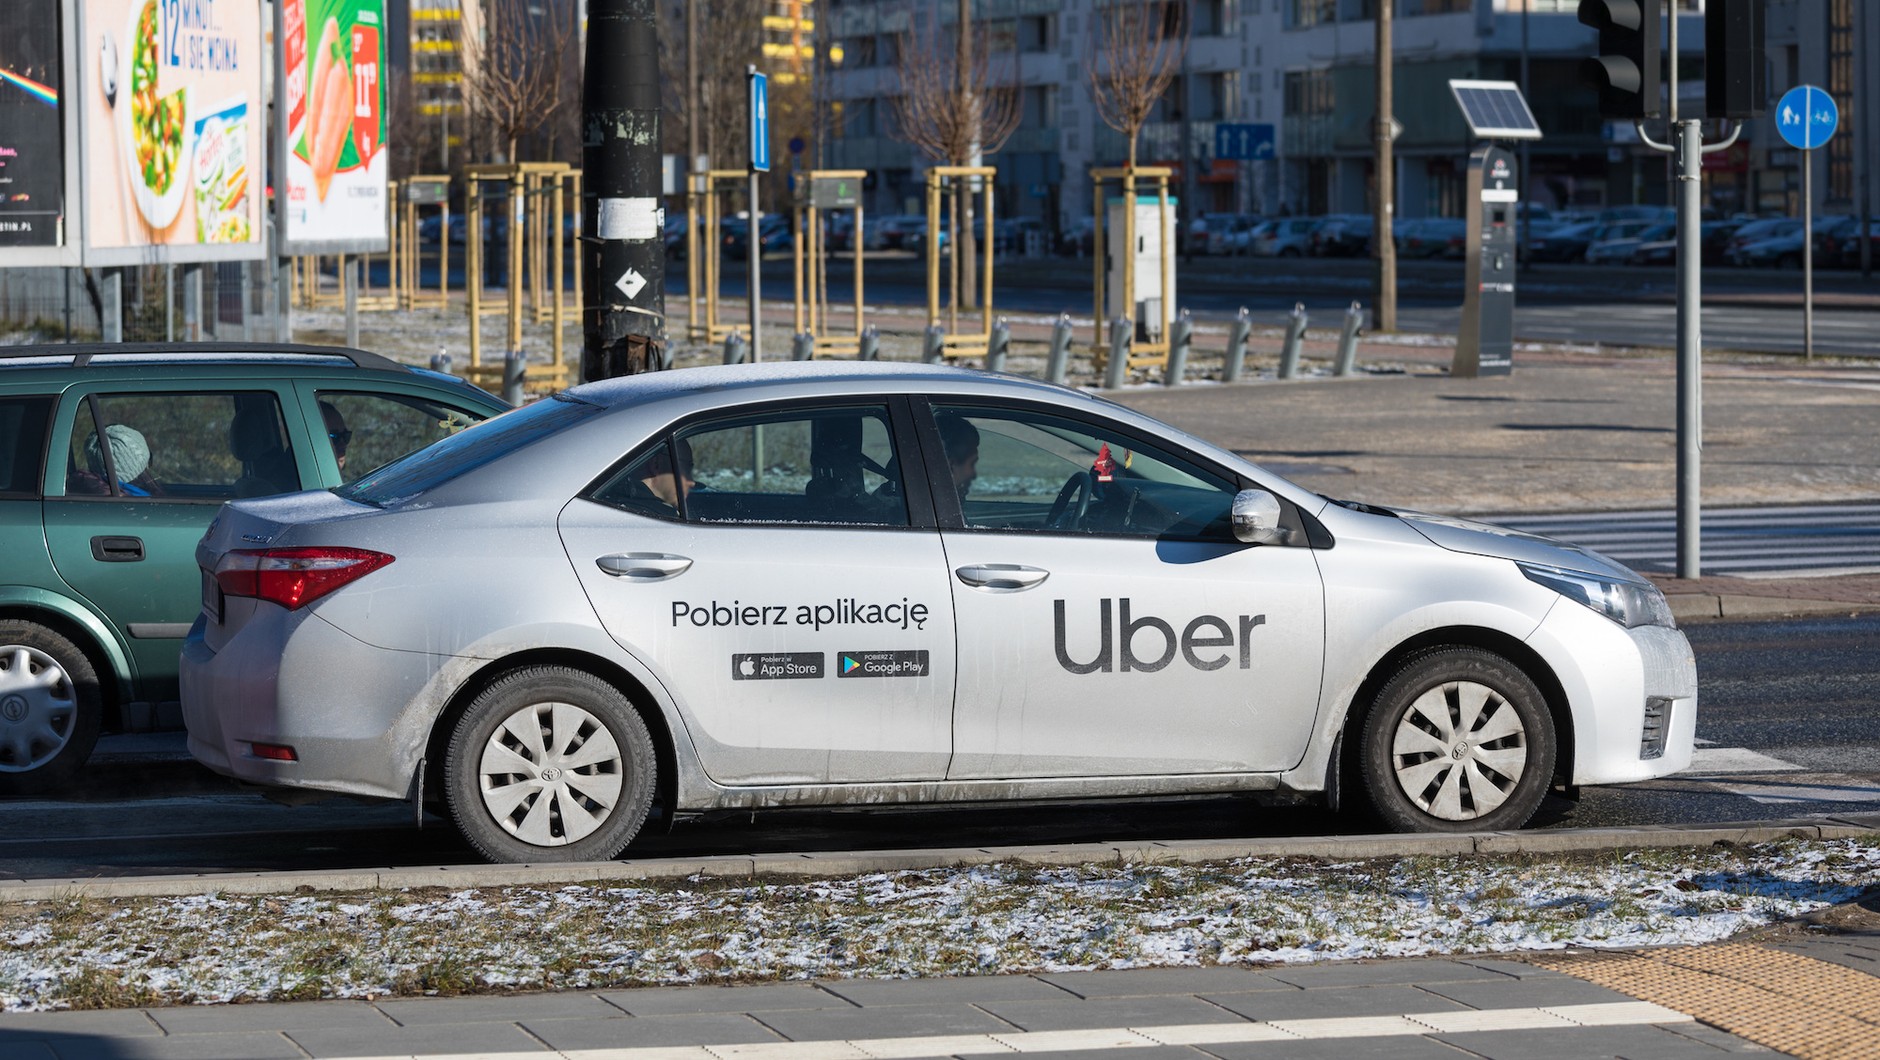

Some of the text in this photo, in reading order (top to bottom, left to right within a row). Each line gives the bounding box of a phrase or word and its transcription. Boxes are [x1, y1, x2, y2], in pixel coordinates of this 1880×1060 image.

[161, 0, 180, 66] 12
[671, 598, 929, 631] Pobierz aplikację
[1053, 597, 1266, 675] Uber
[760, 663, 817, 676] App Store
[864, 661, 924, 674] Google Play
